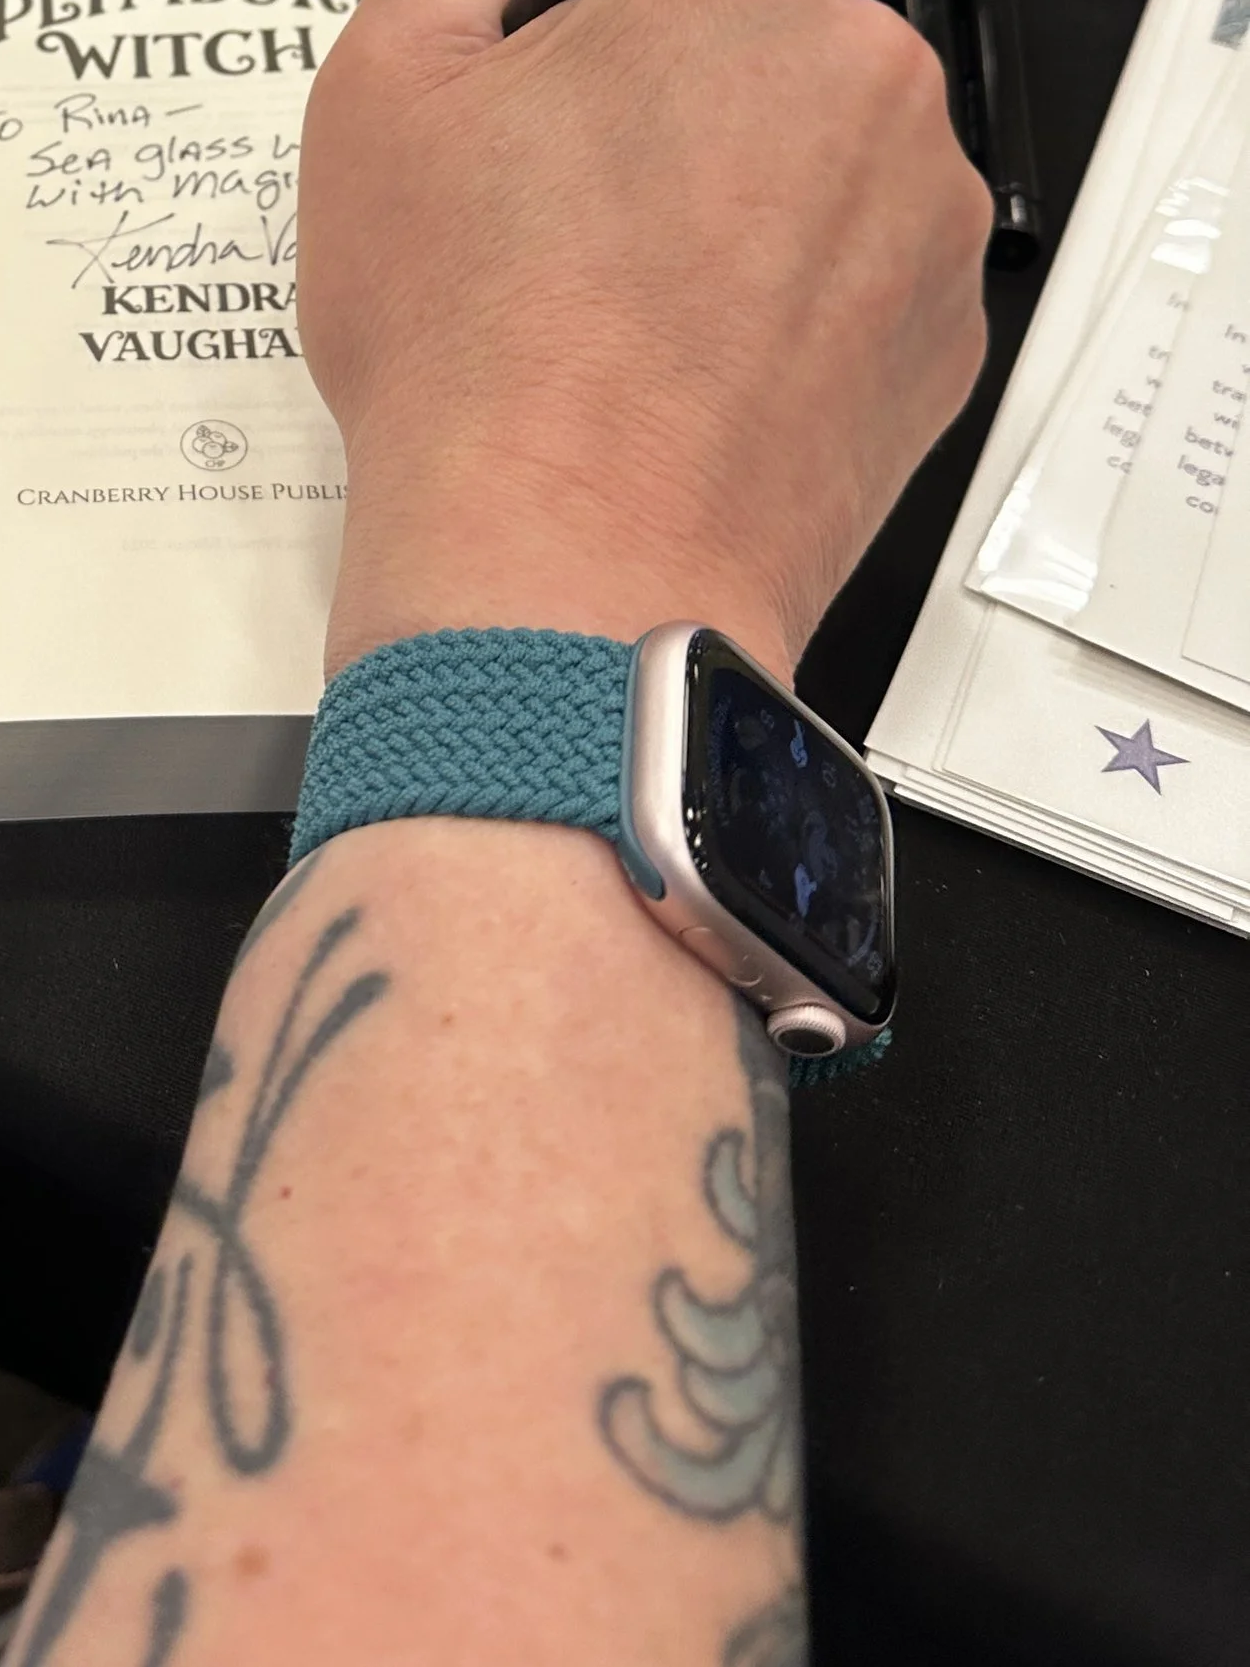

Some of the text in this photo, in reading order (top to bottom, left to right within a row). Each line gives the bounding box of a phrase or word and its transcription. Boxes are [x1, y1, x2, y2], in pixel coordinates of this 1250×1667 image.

[36, 26, 317, 81] WITCH
[135, 135, 254, 181] glass
[25, 169, 298, 210] with magi
[79, 327, 305, 362] VAUGHA
